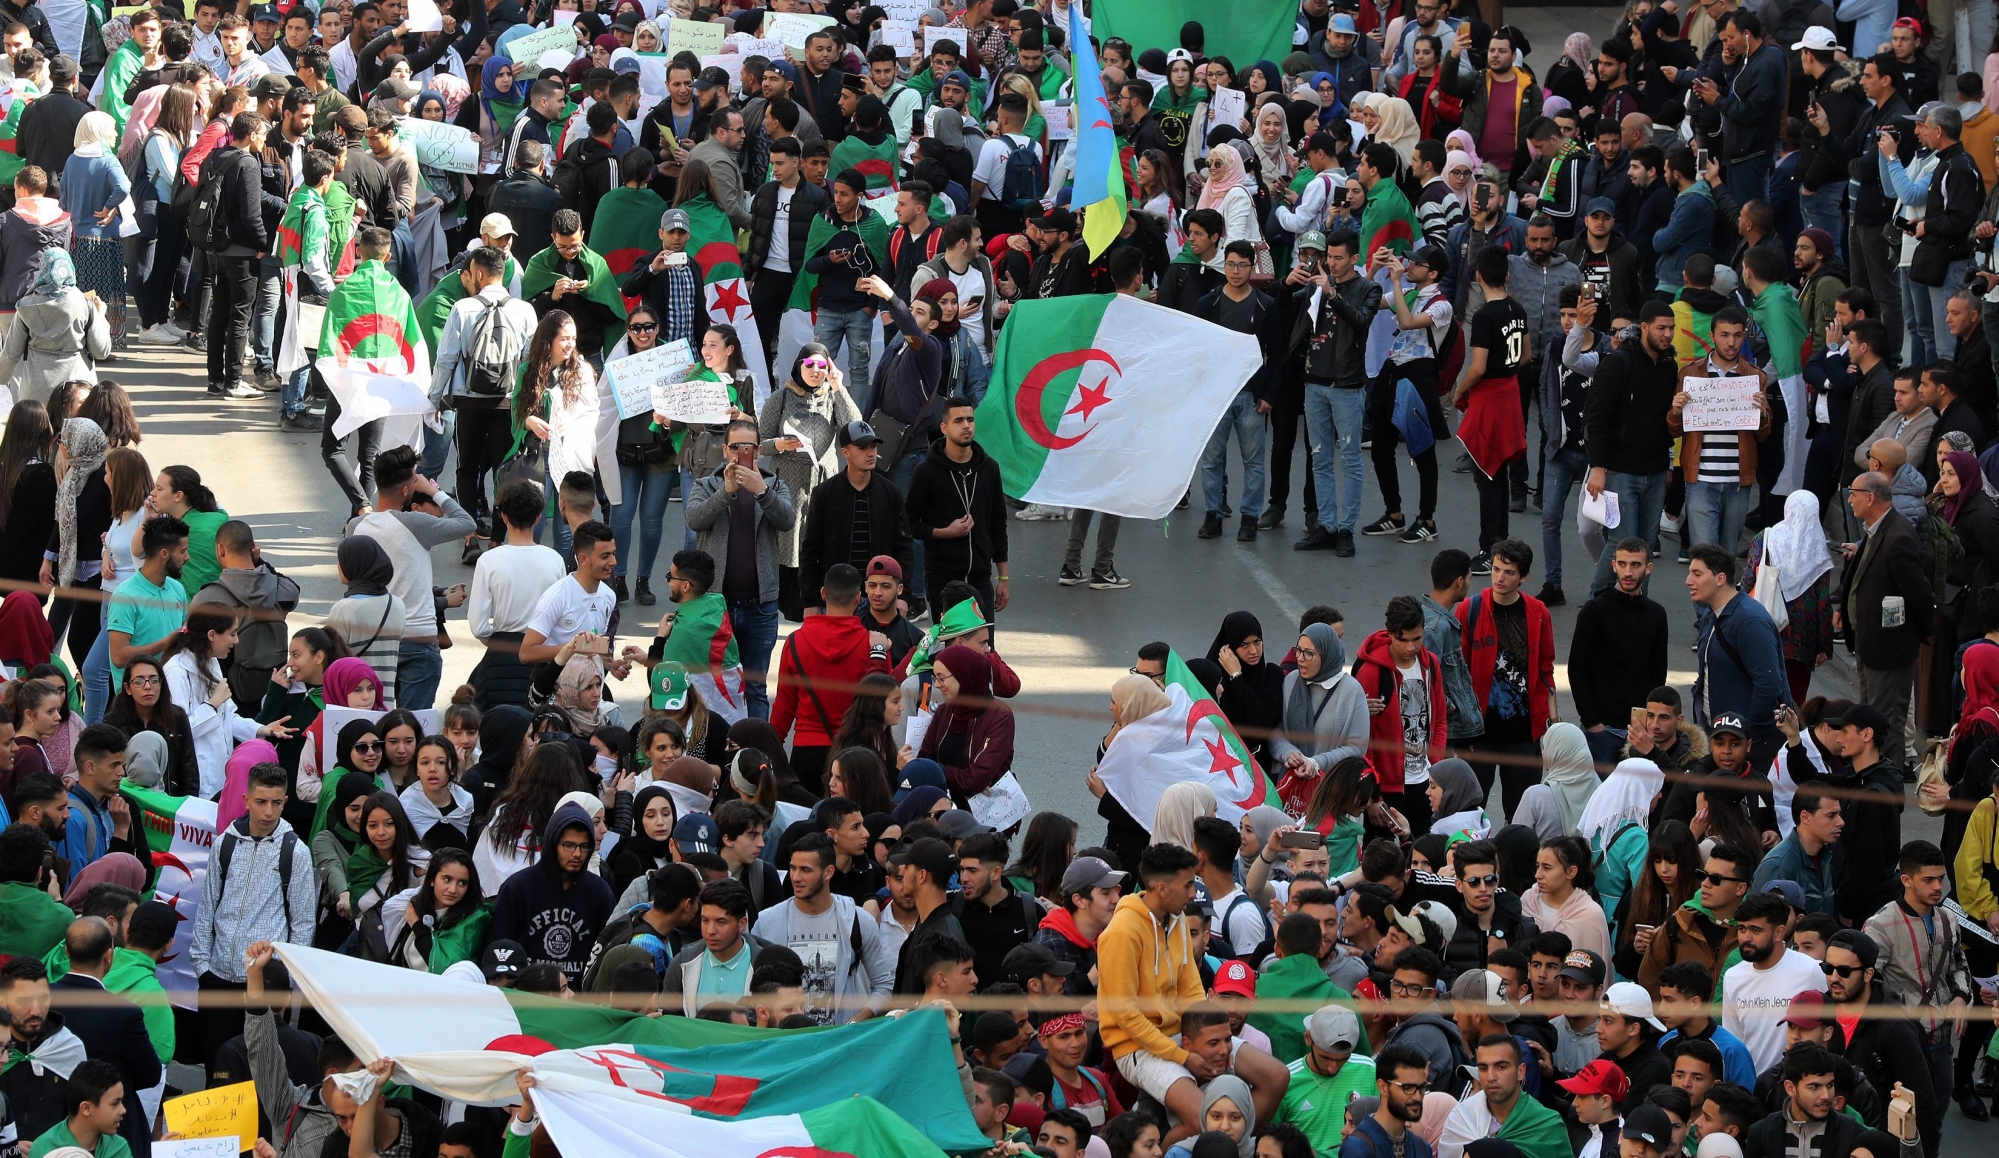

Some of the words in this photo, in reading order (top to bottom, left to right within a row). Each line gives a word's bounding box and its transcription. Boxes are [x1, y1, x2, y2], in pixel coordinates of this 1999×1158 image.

[416, 125, 467, 143] NON
[1501, 318, 1525, 336] PARIS
[1504, 331, 1522, 365] 10
[612, 359, 633, 371] NON
[1713, 716, 1742, 729] FILA
[144, 810, 176, 837] THRI
[180, 822, 213, 850] VIVA
[1736, 997, 1755, 1009] Calvin
[1754, 996, 1771, 1009] Klein
